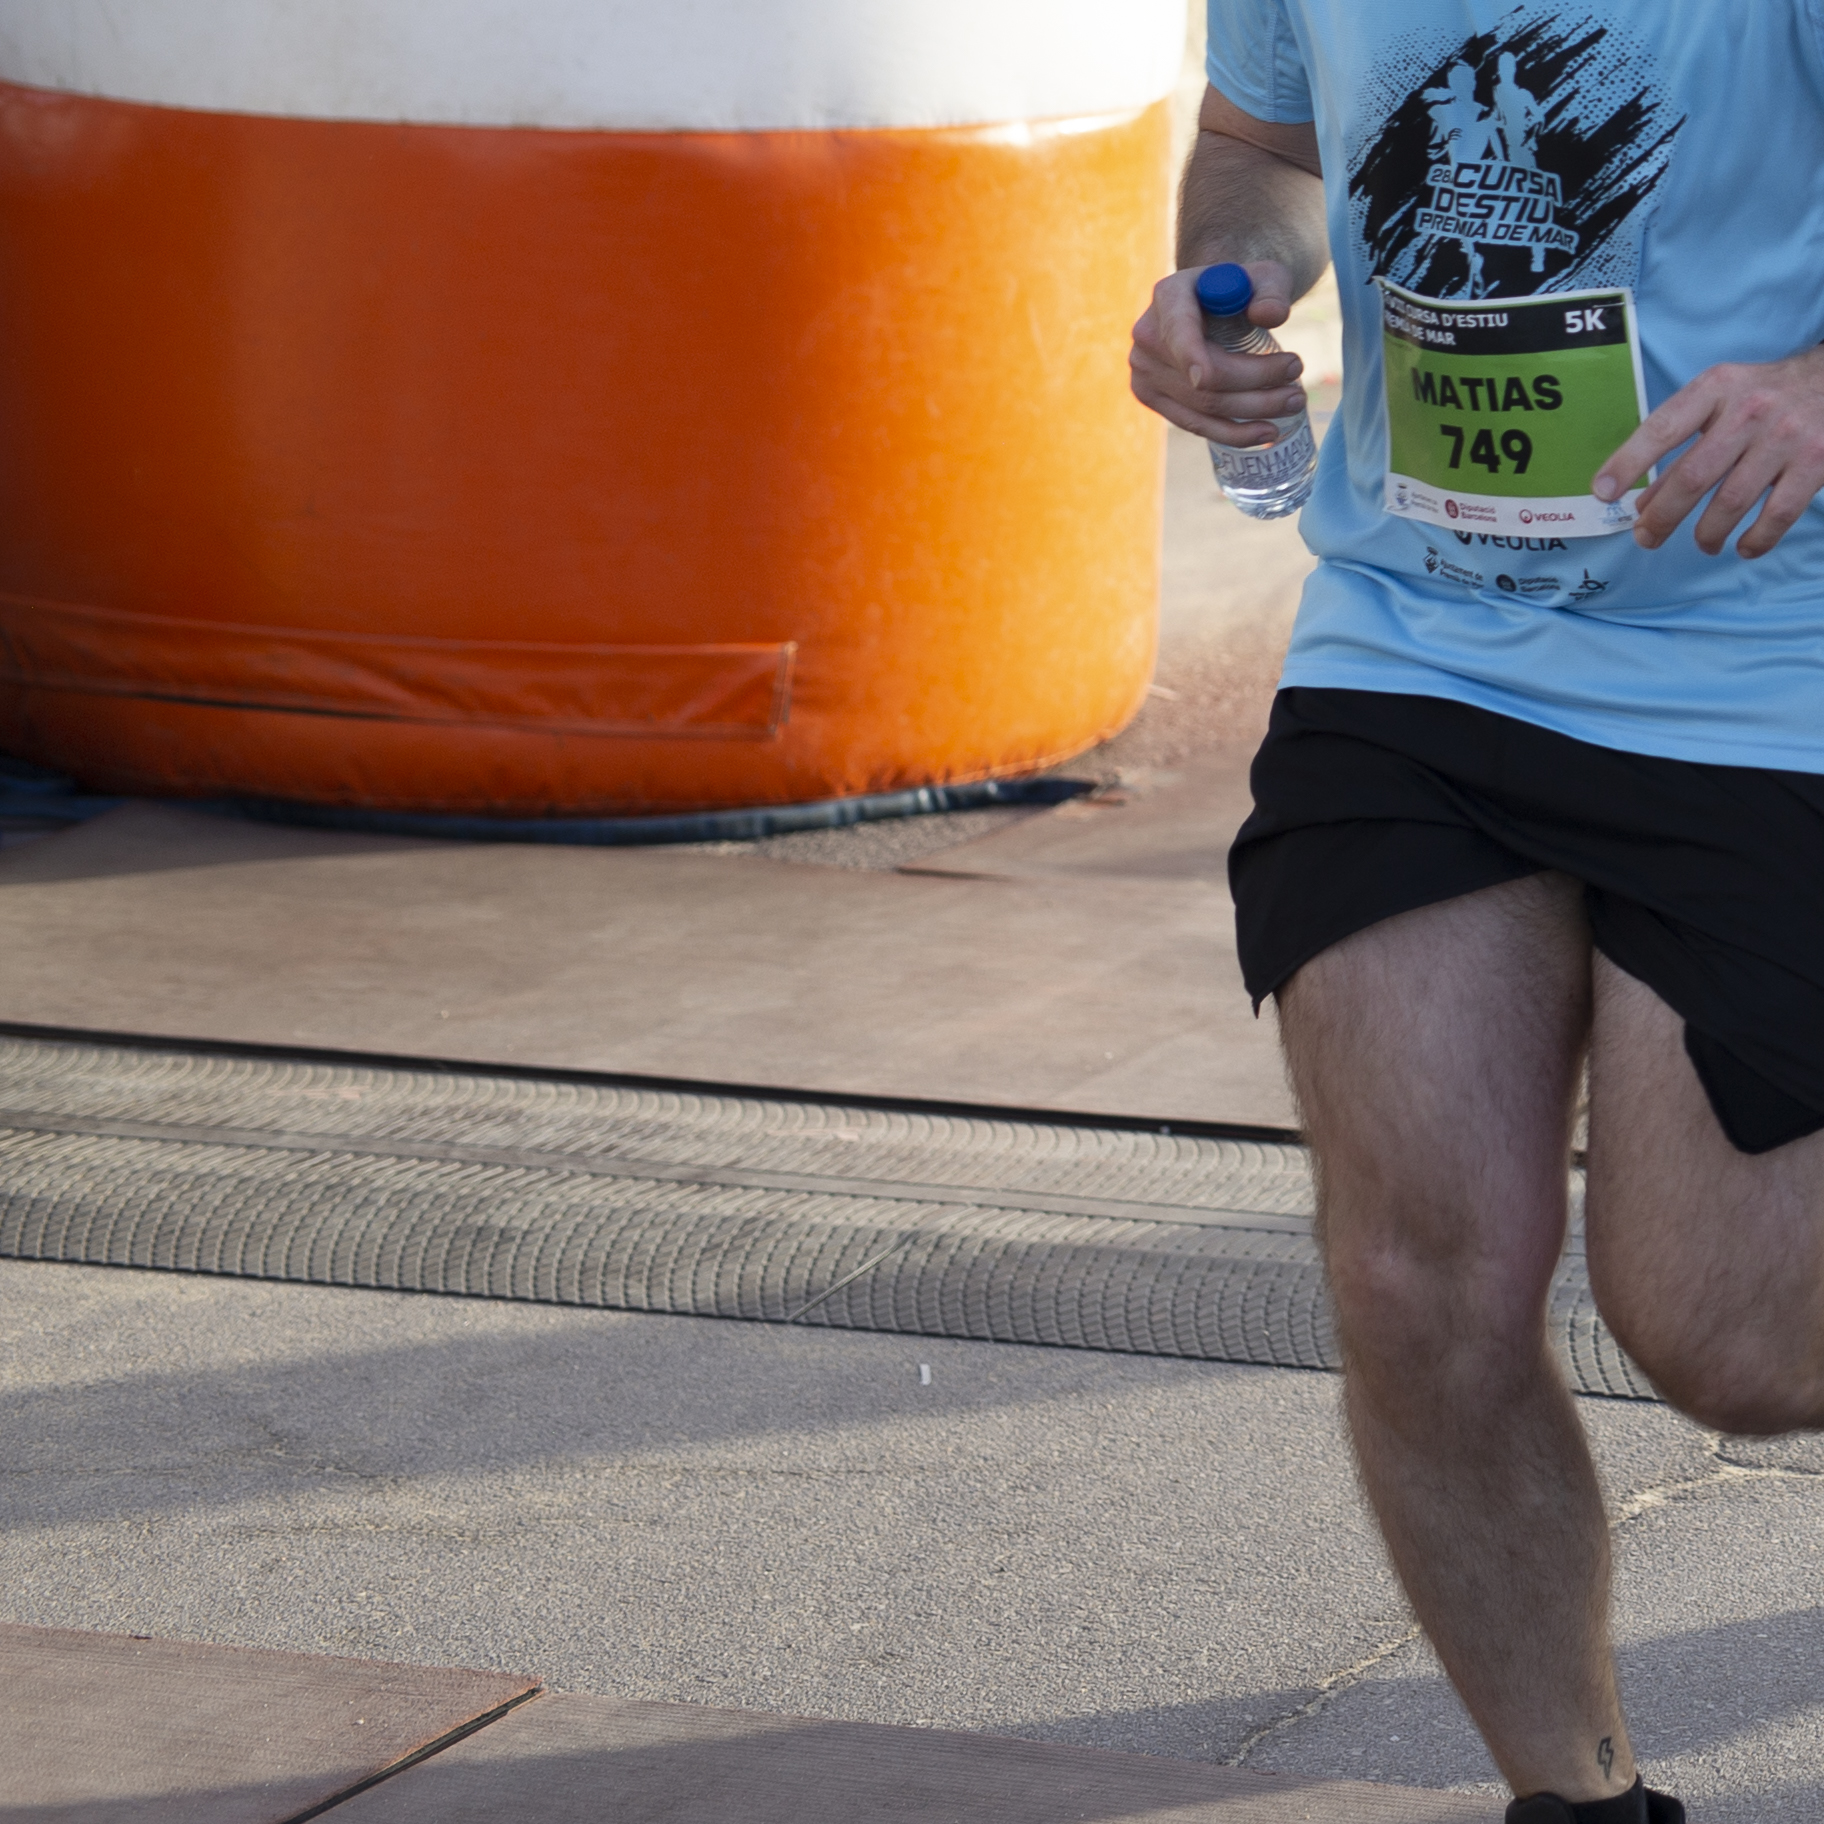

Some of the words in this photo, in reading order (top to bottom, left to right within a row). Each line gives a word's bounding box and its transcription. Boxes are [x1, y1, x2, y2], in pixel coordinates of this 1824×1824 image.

[1453, 161, 1561, 204] CURSA
[1491, 223, 1527, 242] DE
[1527, 225, 1575, 249] MAR
[1441, 312, 1509, 328] D'ESTIU
[1563, 308, 1607, 334] 5K
[1425, 328, 1457, 346] MAR
[1411, 367, 1564, 413] MATIAS
[1440, 424, 1533, 475] 749
[1534, 512, 1575, 522] VEOLIA
